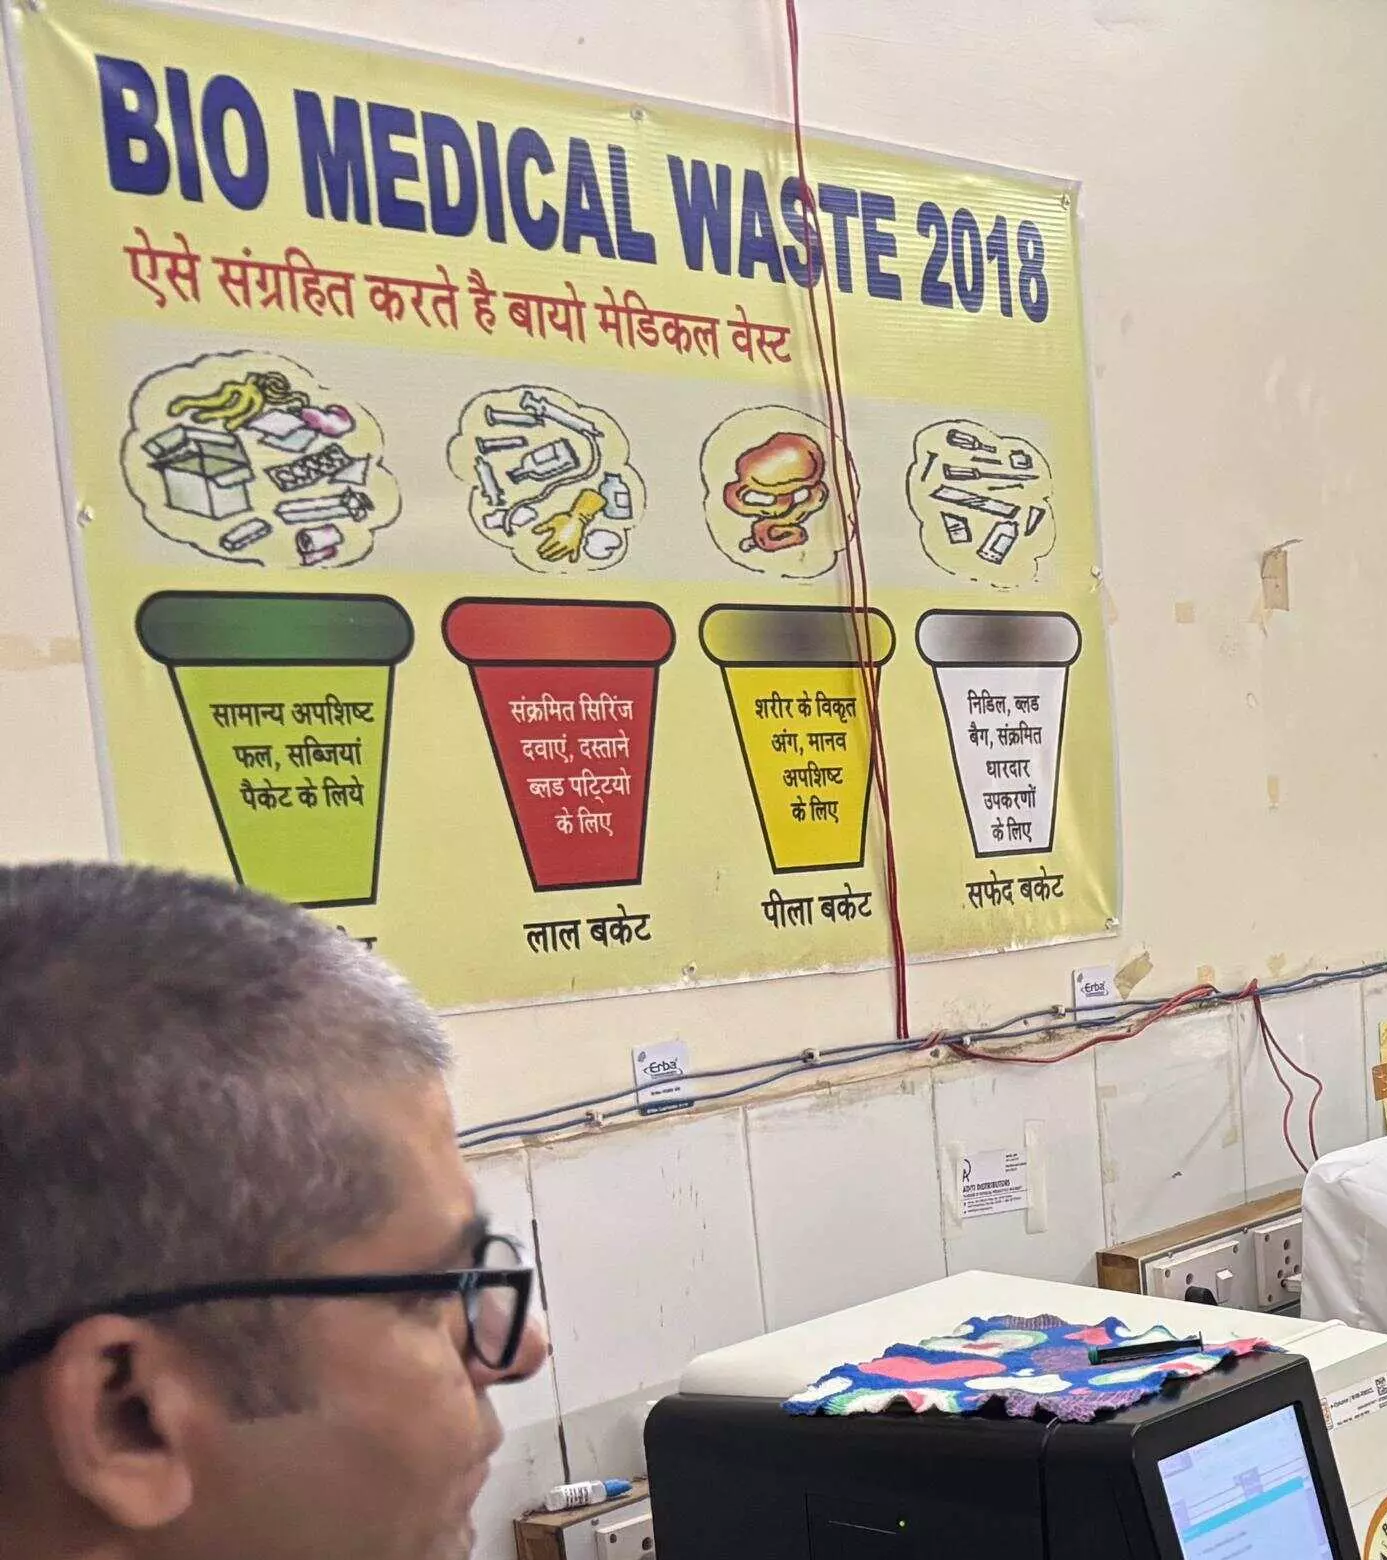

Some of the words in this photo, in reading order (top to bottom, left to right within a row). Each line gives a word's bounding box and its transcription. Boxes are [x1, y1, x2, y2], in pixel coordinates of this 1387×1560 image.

[95, 54, 268, 211] BIO
[293, 89, 657, 265] MEDICAL
[669, 155, 901, 300] WASTE
[918, 199, 1050, 324] 2018
[123, 226, 200, 308] ऐसे
[212, 246, 355, 318] संग्रहित
[364, 264, 459, 330] करते
[467, 267, 496, 335] है
[503, 280, 586, 344] बायो
[594, 285, 720, 360] मेडिकल
[727, 304, 792, 364] वेस्ट
[209, 703, 285, 728] सामान्य
[292, 693, 375, 726] अपशिष्ट
[508, 692, 575, 723] संक्रमित
[579, 692, 634, 722] सिरिंज
[755, 691, 794, 719] शरीर
[796, 690, 812, 719] के
[815, 690, 857, 723] विकृत
[1014, 696, 1040, 713] ब्लड
[578, 729, 630, 759] दस्ताने
[807, 731, 847, 753] मानव
[996, 720, 1042, 746] संक्रमित
[285, 735, 362, 767] सब्जियां
[782, 761, 844, 788] अपशिष्ट
[986, 759, 1031, 779] धारदार
[240, 778, 293, 810] पैकेट
[295, 777, 318, 809] के
[322, 775, 365, 807] लिये
[526, 778, 564, 798] ब्लड
[983, 784, 1037, 810] उपकरणों
[555, 807, 573, 834] के
[577, 806, 614, 837] लिए
[790, 796, 807, 823] के
[810, 795, 839, 824] लिए
[991, 817, 1004, 842] के
[1007, 816, 1033, 843] लिए
[965, 869, 1015, 909] सफेद
[1017, 865, 1064, 902] बकेट
[761, 888, 814, 929] पीला
[818, 882, 873, 923] बकेट
[523, 919, 581, 954] लाल
[587, 903, 652, 947] बकेट
